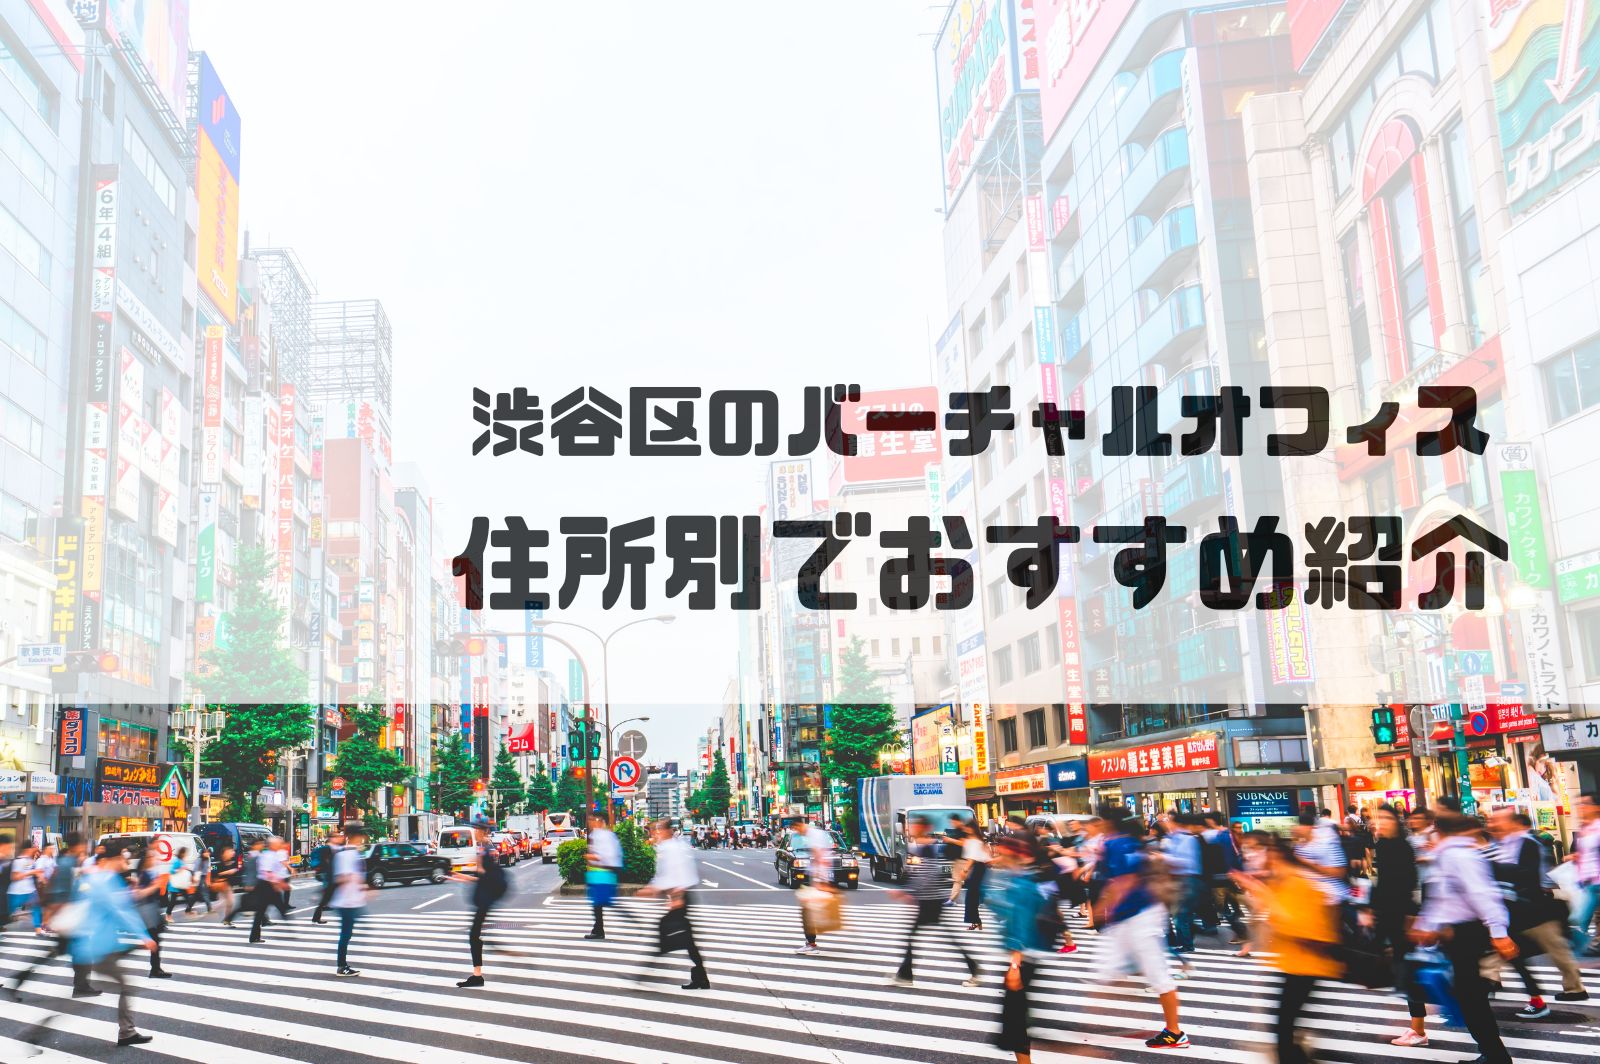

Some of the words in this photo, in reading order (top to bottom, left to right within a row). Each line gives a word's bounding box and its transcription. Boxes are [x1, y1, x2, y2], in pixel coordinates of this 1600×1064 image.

[943, 0, 1006, 154] SUNPARK
[97, 189, 114, 260] 6年4組
[95, 324, 105, 393] ザ・ロックアップ
[87, 506, 99, 580] アラビアンロック
[201, 545, 213, 578] レイク
[82, 605, 93, 650] ミステリアス
[66, 721, 79, 758] ダイコク
[1031, 780, 1044, 789] GAME
[1058, 771, 1077, 783] atmos
[112, 789, 140, 806] ダイコク
[1236, 791, 1288, 801] SUBNADE
